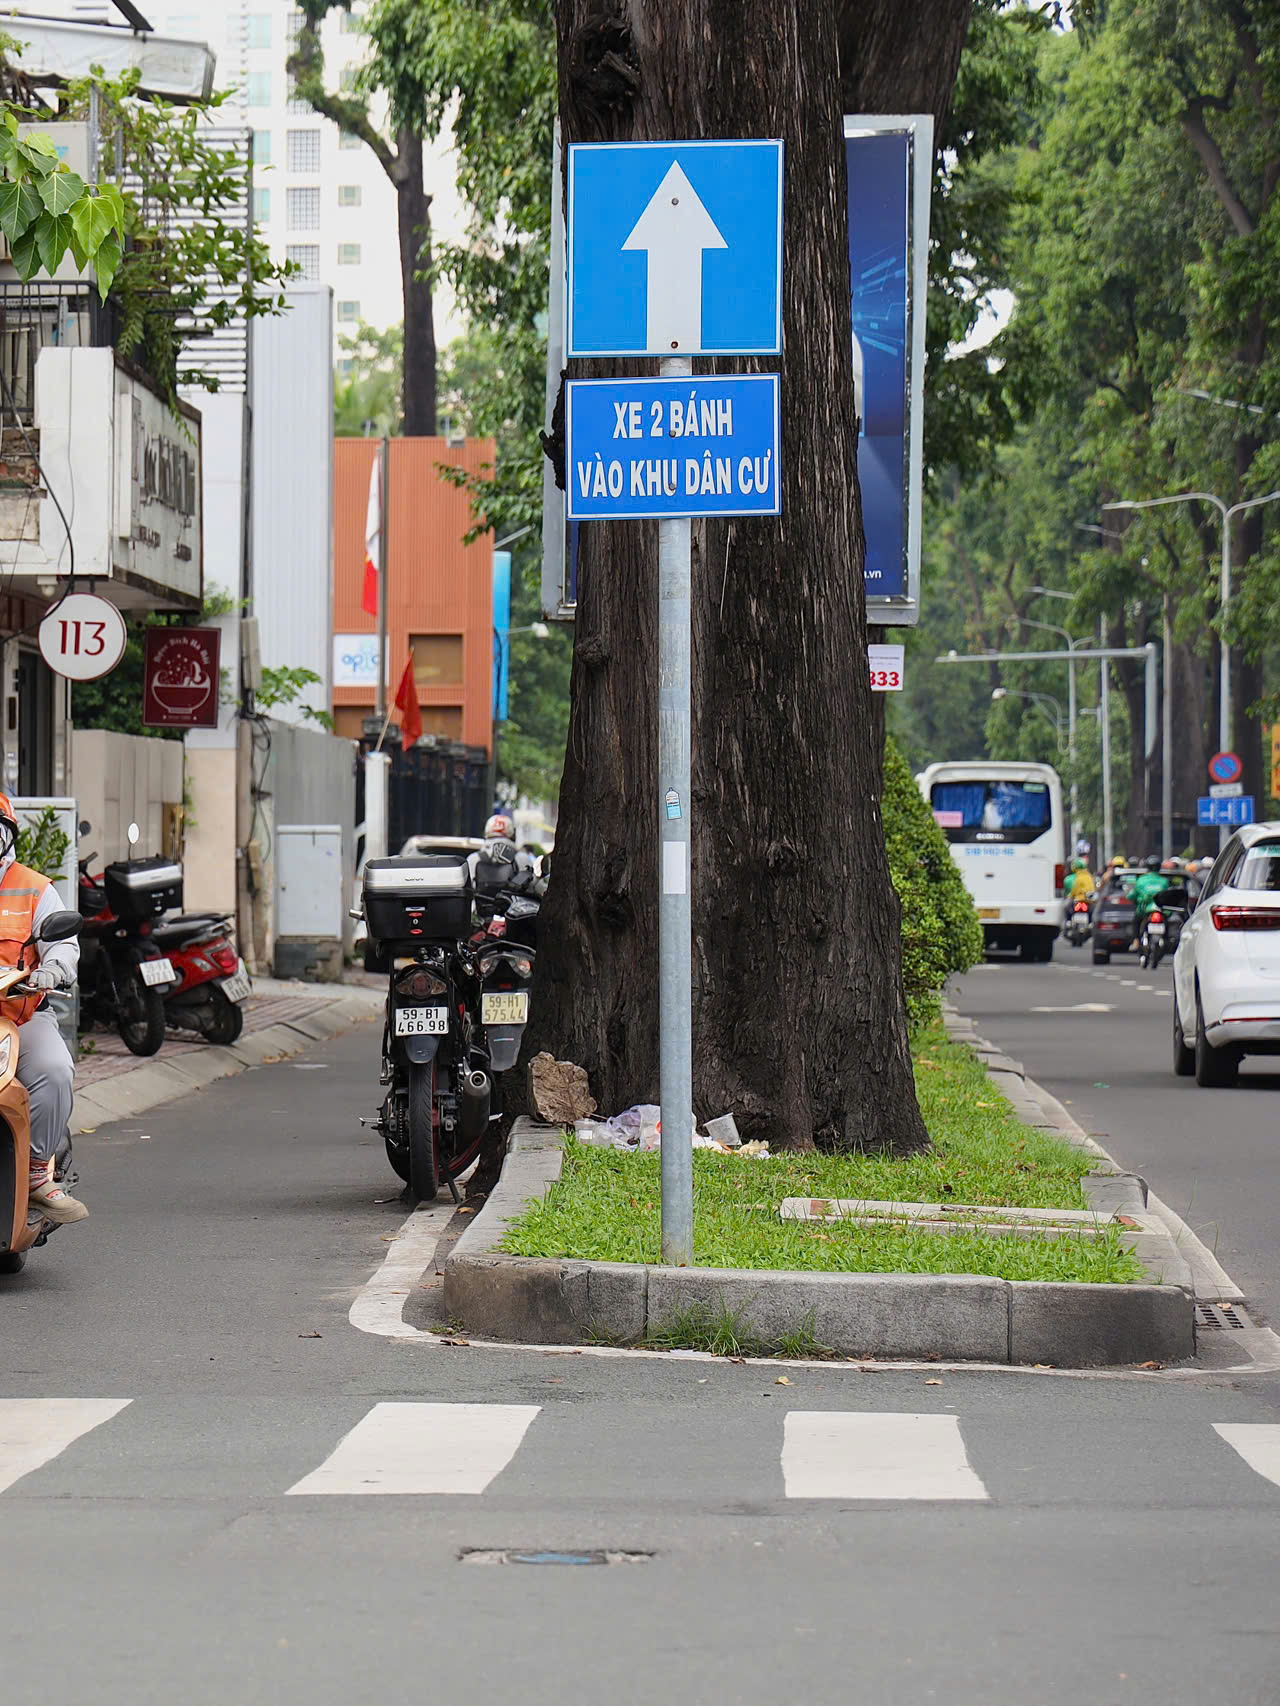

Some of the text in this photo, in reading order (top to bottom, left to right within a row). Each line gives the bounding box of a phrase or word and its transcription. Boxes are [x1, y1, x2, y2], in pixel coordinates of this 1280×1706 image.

[612, 390, 733, 439] XE 2 BÁNH
[577, 448, 771, 498] VÀO KHU DÂN CƯ
[58, 619, 106, 656] 113
[489, 995, 519, 1009] 59-H1
[403, 1008, 439, 1020] 59-B1
[484, 1009, 524, 1022] 575.44
[398, 1020, 445, 1034] 466.98
